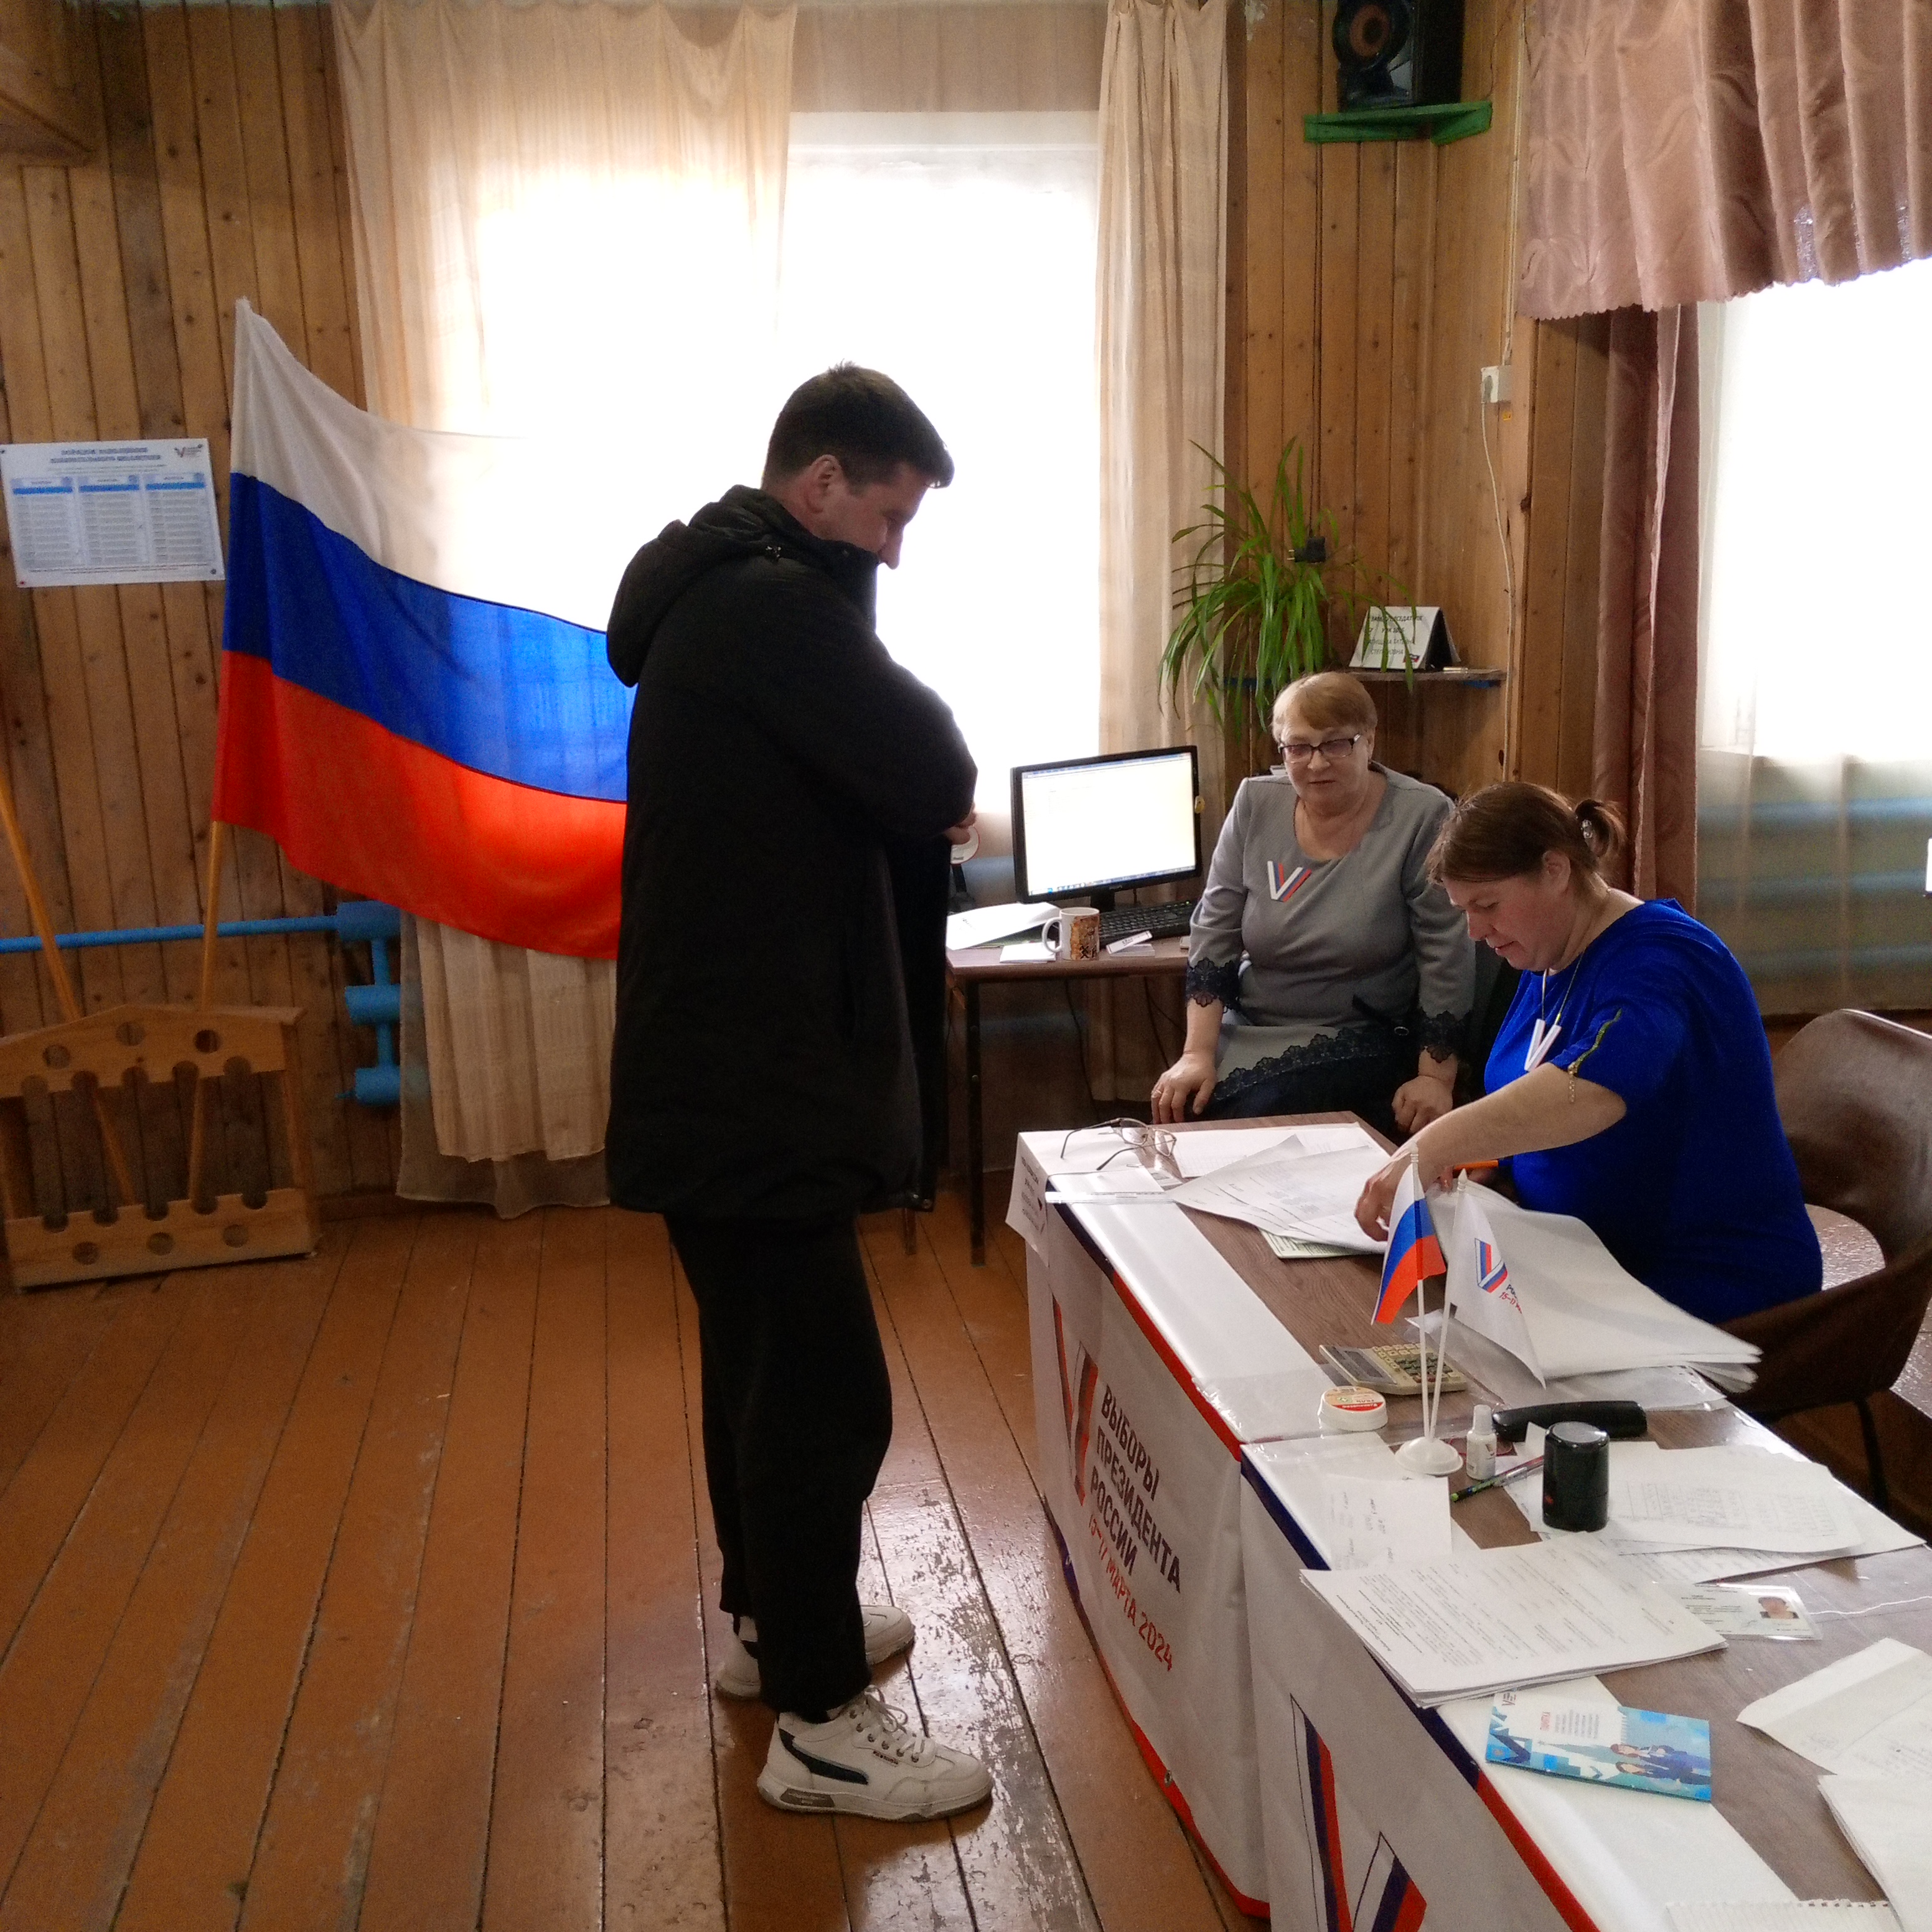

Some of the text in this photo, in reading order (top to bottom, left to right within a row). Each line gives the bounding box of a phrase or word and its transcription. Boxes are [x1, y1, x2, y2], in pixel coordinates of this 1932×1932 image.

[1101, 1383, 1160, 1502] ВЫБОРЫ
[1090, 1465, 1138, 1576] РОССИИ
[1097, 1425, 1181, 1594] ПРЕЗИДЕНТА
[1106, 1556, 1137, 1627] МАРТА
[1138, 1611, 1172, 1672] 2024
